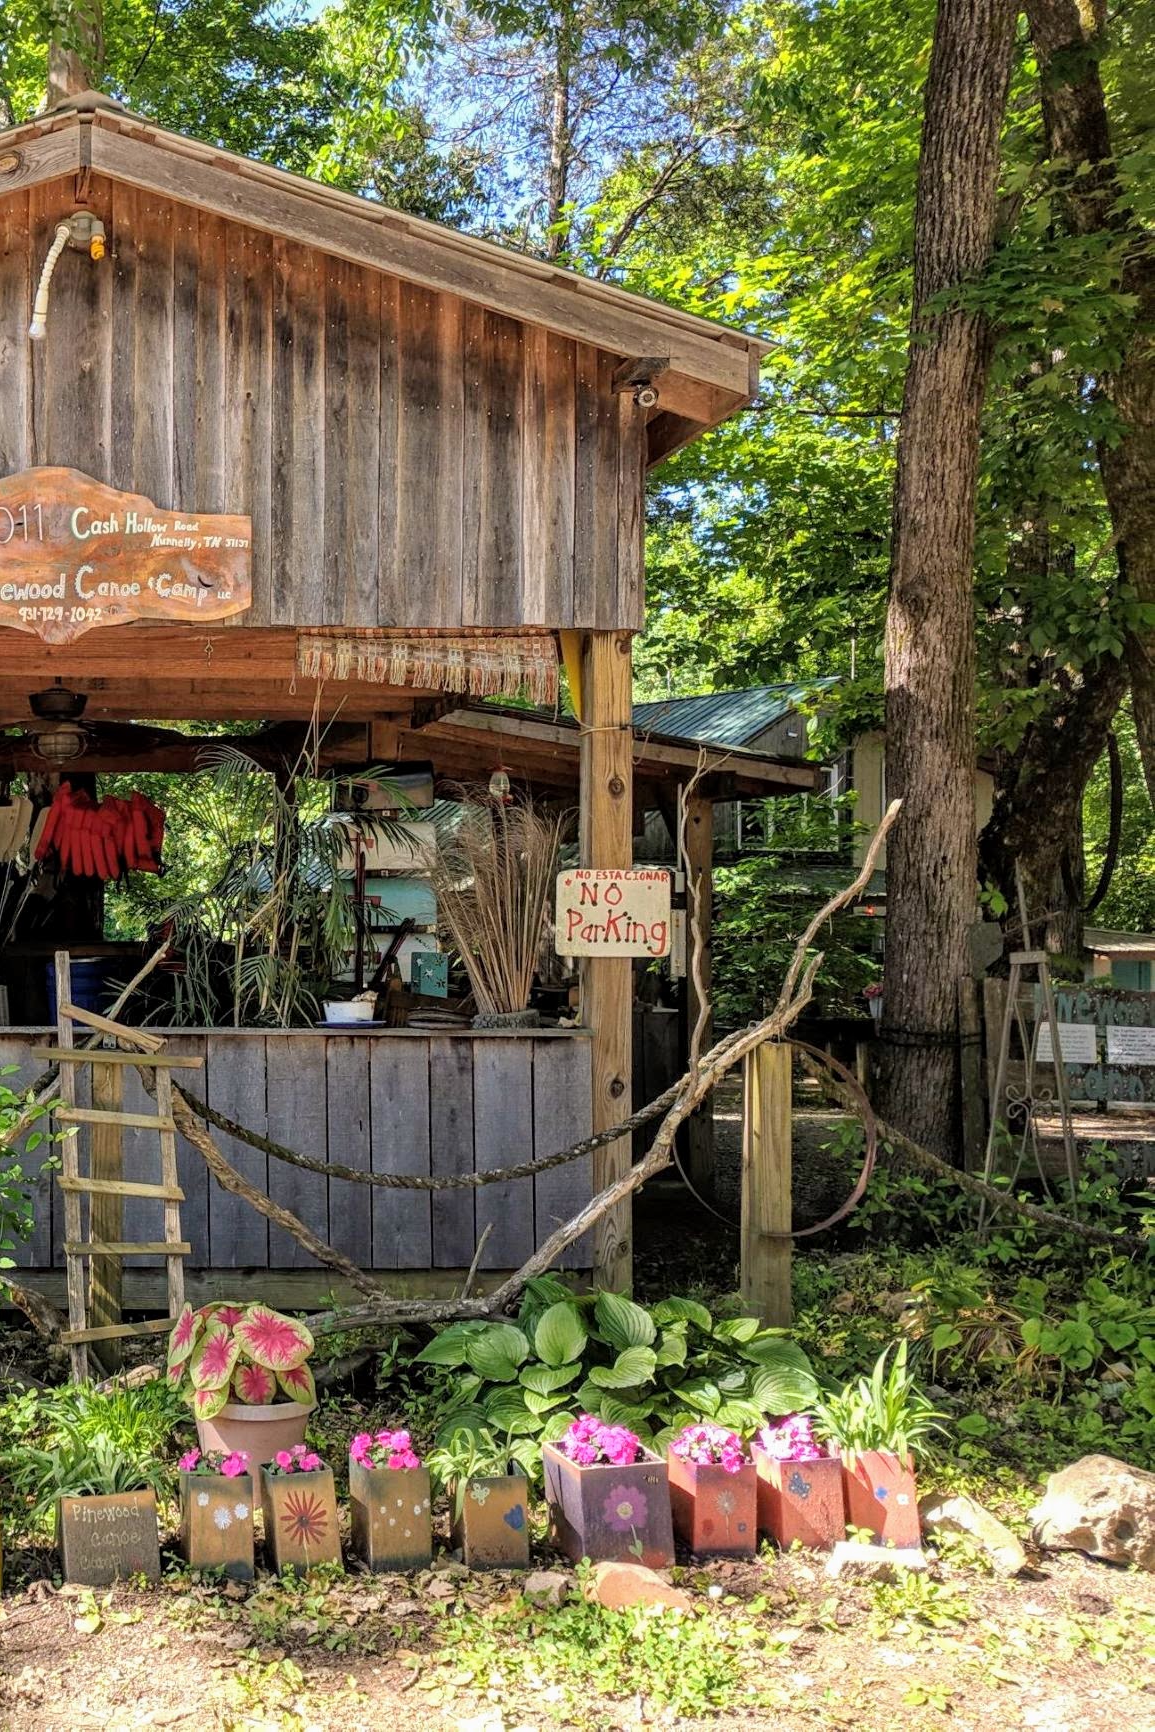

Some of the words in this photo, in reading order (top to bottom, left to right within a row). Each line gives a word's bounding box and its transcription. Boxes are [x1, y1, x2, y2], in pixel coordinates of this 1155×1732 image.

[71, 507, 120, 540] Cash
[125, 512, 167, 534] Hollow
[174, 520, 199, 532] Road
[203, 535, 223, 548] TN
[75, 565, 141, 601] Canoe
[155, 572, 208, 607] Camp
[217, 591, 232, 600] LLC
[575, 870, 591, 880] NO
[596, 871, 669, 882] ESTACIONAR
[580, 882, 623, 906] NO
[72, 1497, 140, 1523] Pinewood
